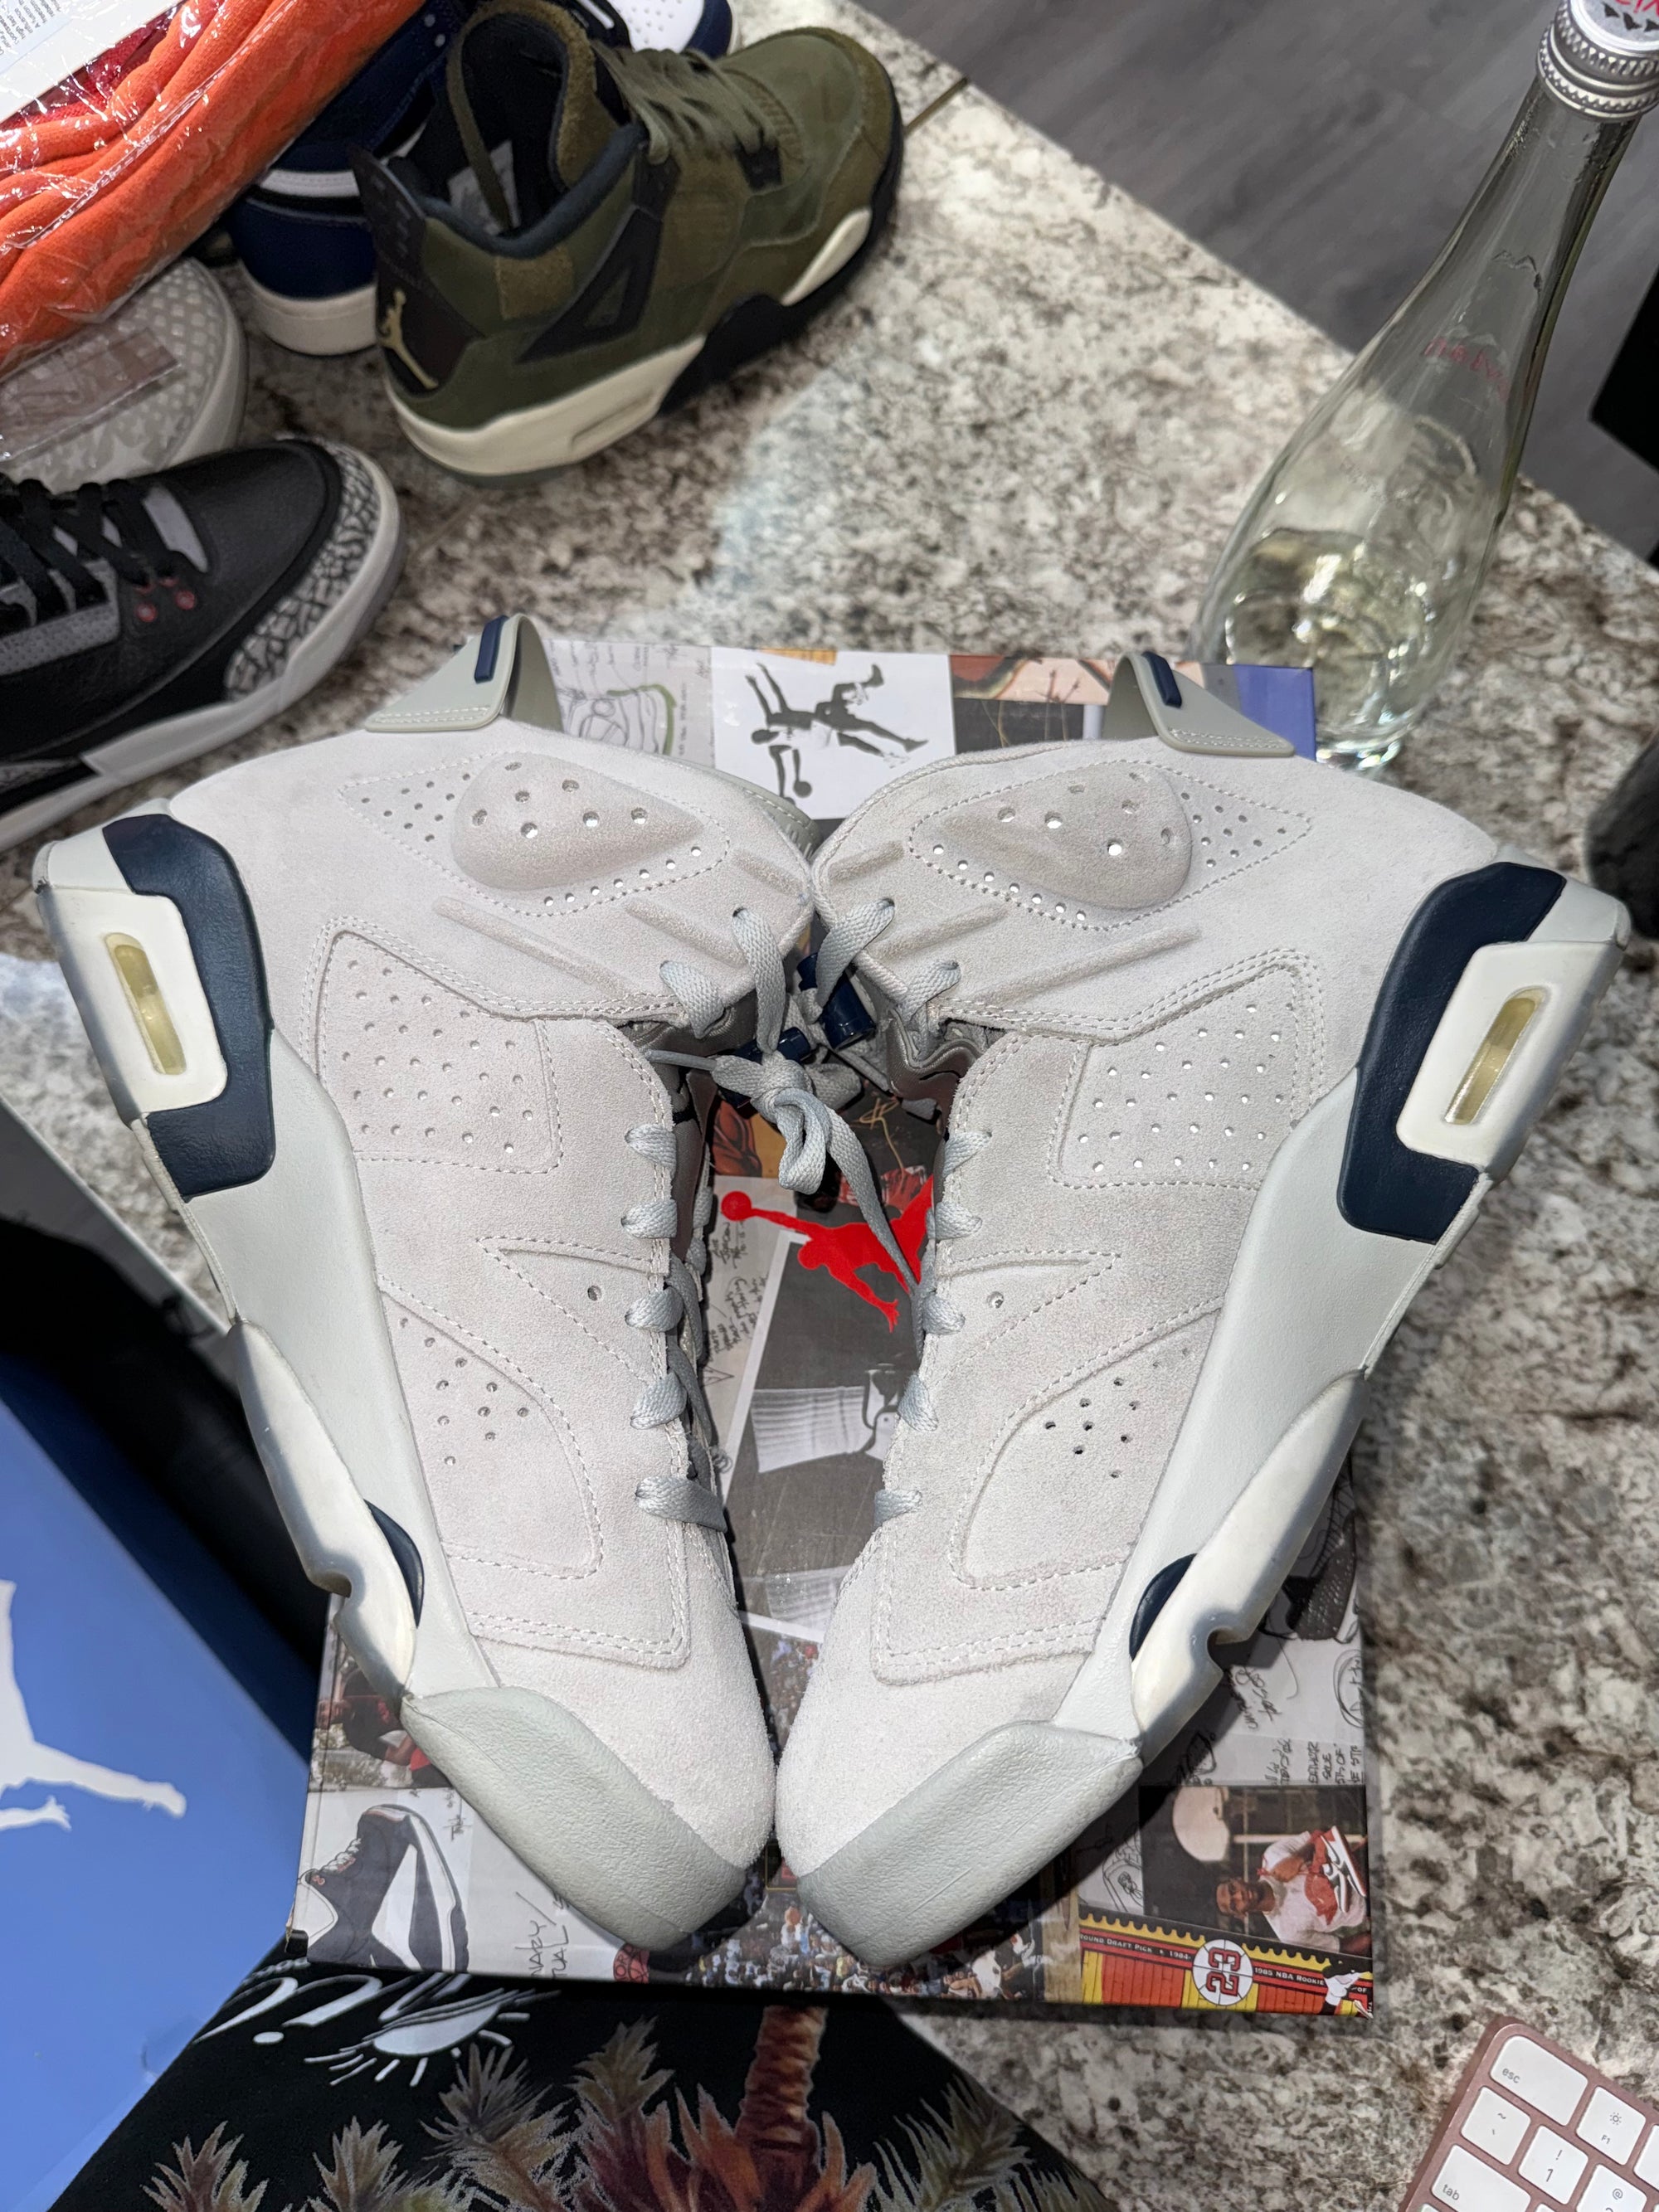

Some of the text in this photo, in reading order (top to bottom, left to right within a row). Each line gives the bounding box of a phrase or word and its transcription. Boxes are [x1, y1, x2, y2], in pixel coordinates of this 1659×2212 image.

[1205, 1947, 1242, 1996] 23
[1254, 1966, 1273, 1976] 1985
[1275, 1970, 1295, 1980] NBA
[1501, 2067, 1520, 2084] esc
[1601, 2134, 1611, 2145] F1
[1555, 2149, 1563, 2161] !
[1545, 2168, 1554, 2183] 1
[1442, 2183, 1460, 2201] tab
[1612, 2188, 1623, 2200] @
